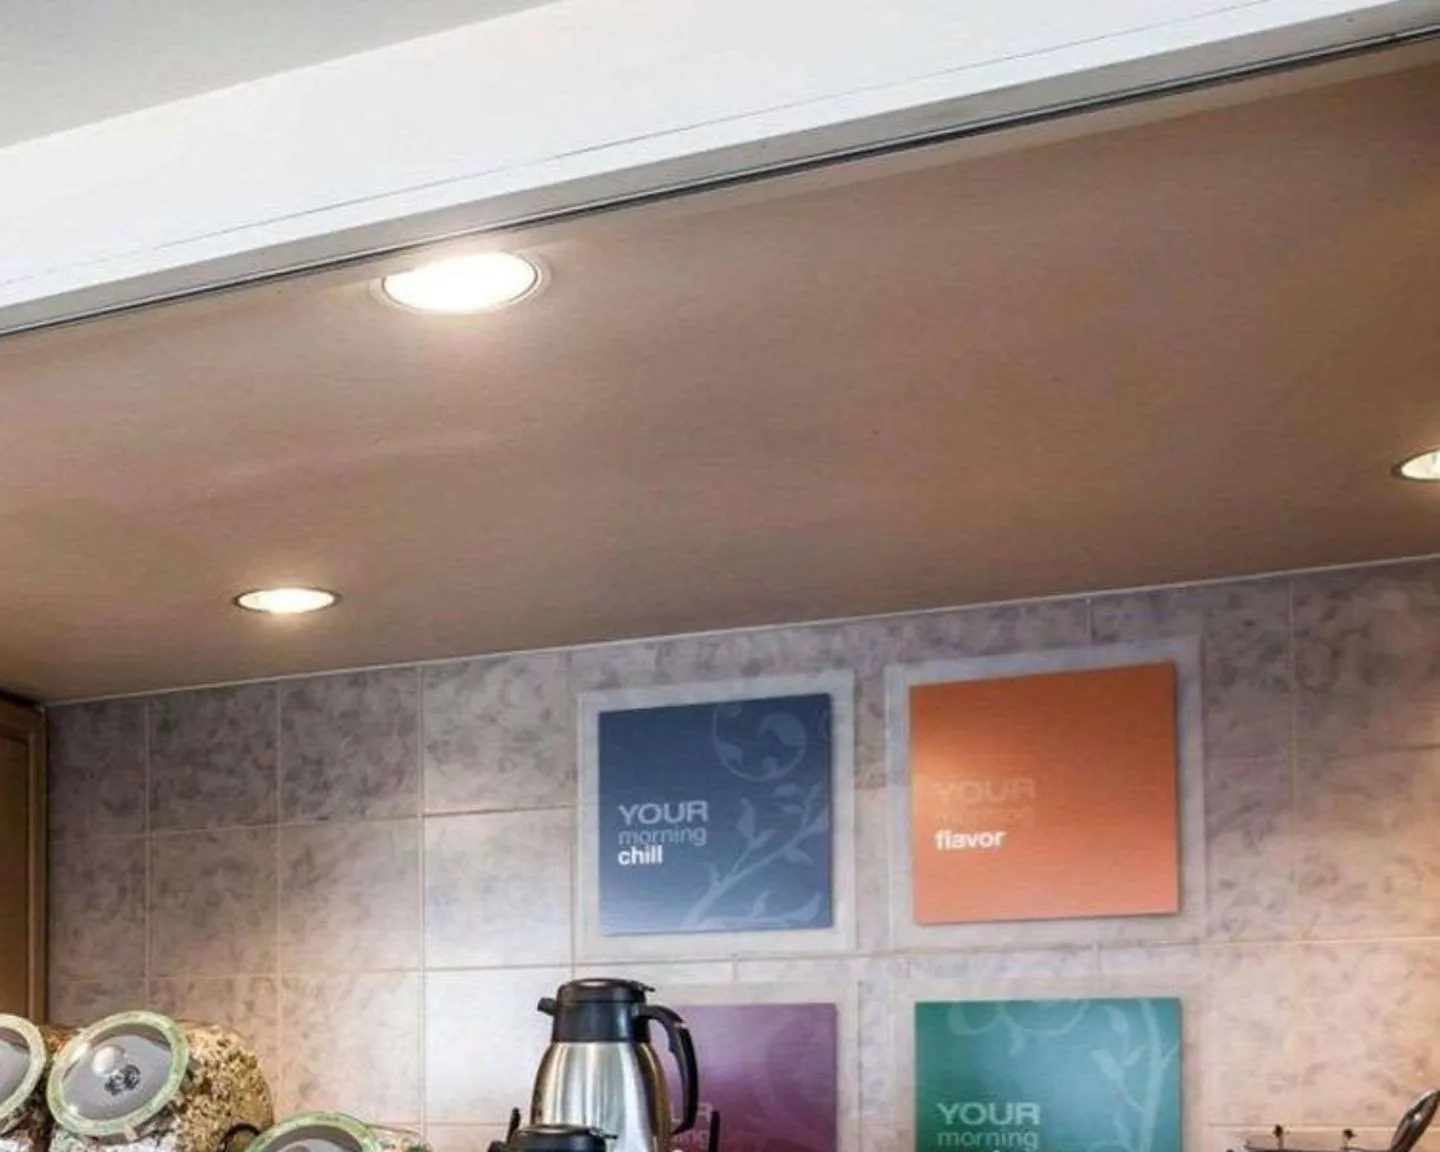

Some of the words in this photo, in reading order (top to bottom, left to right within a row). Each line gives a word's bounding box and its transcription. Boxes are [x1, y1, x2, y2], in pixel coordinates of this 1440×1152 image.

[932, 778, 1037, 804] YOUR
[618, 800, 709, 825] YOUR
[618, 827, 707, 847] morning
[934, 829, 1007, 851] flavor
[618, 844, 663, 865] chill
[936, 1101, 1041, 1125] YOUR
[937, 1131, 1039, 1152] morning
